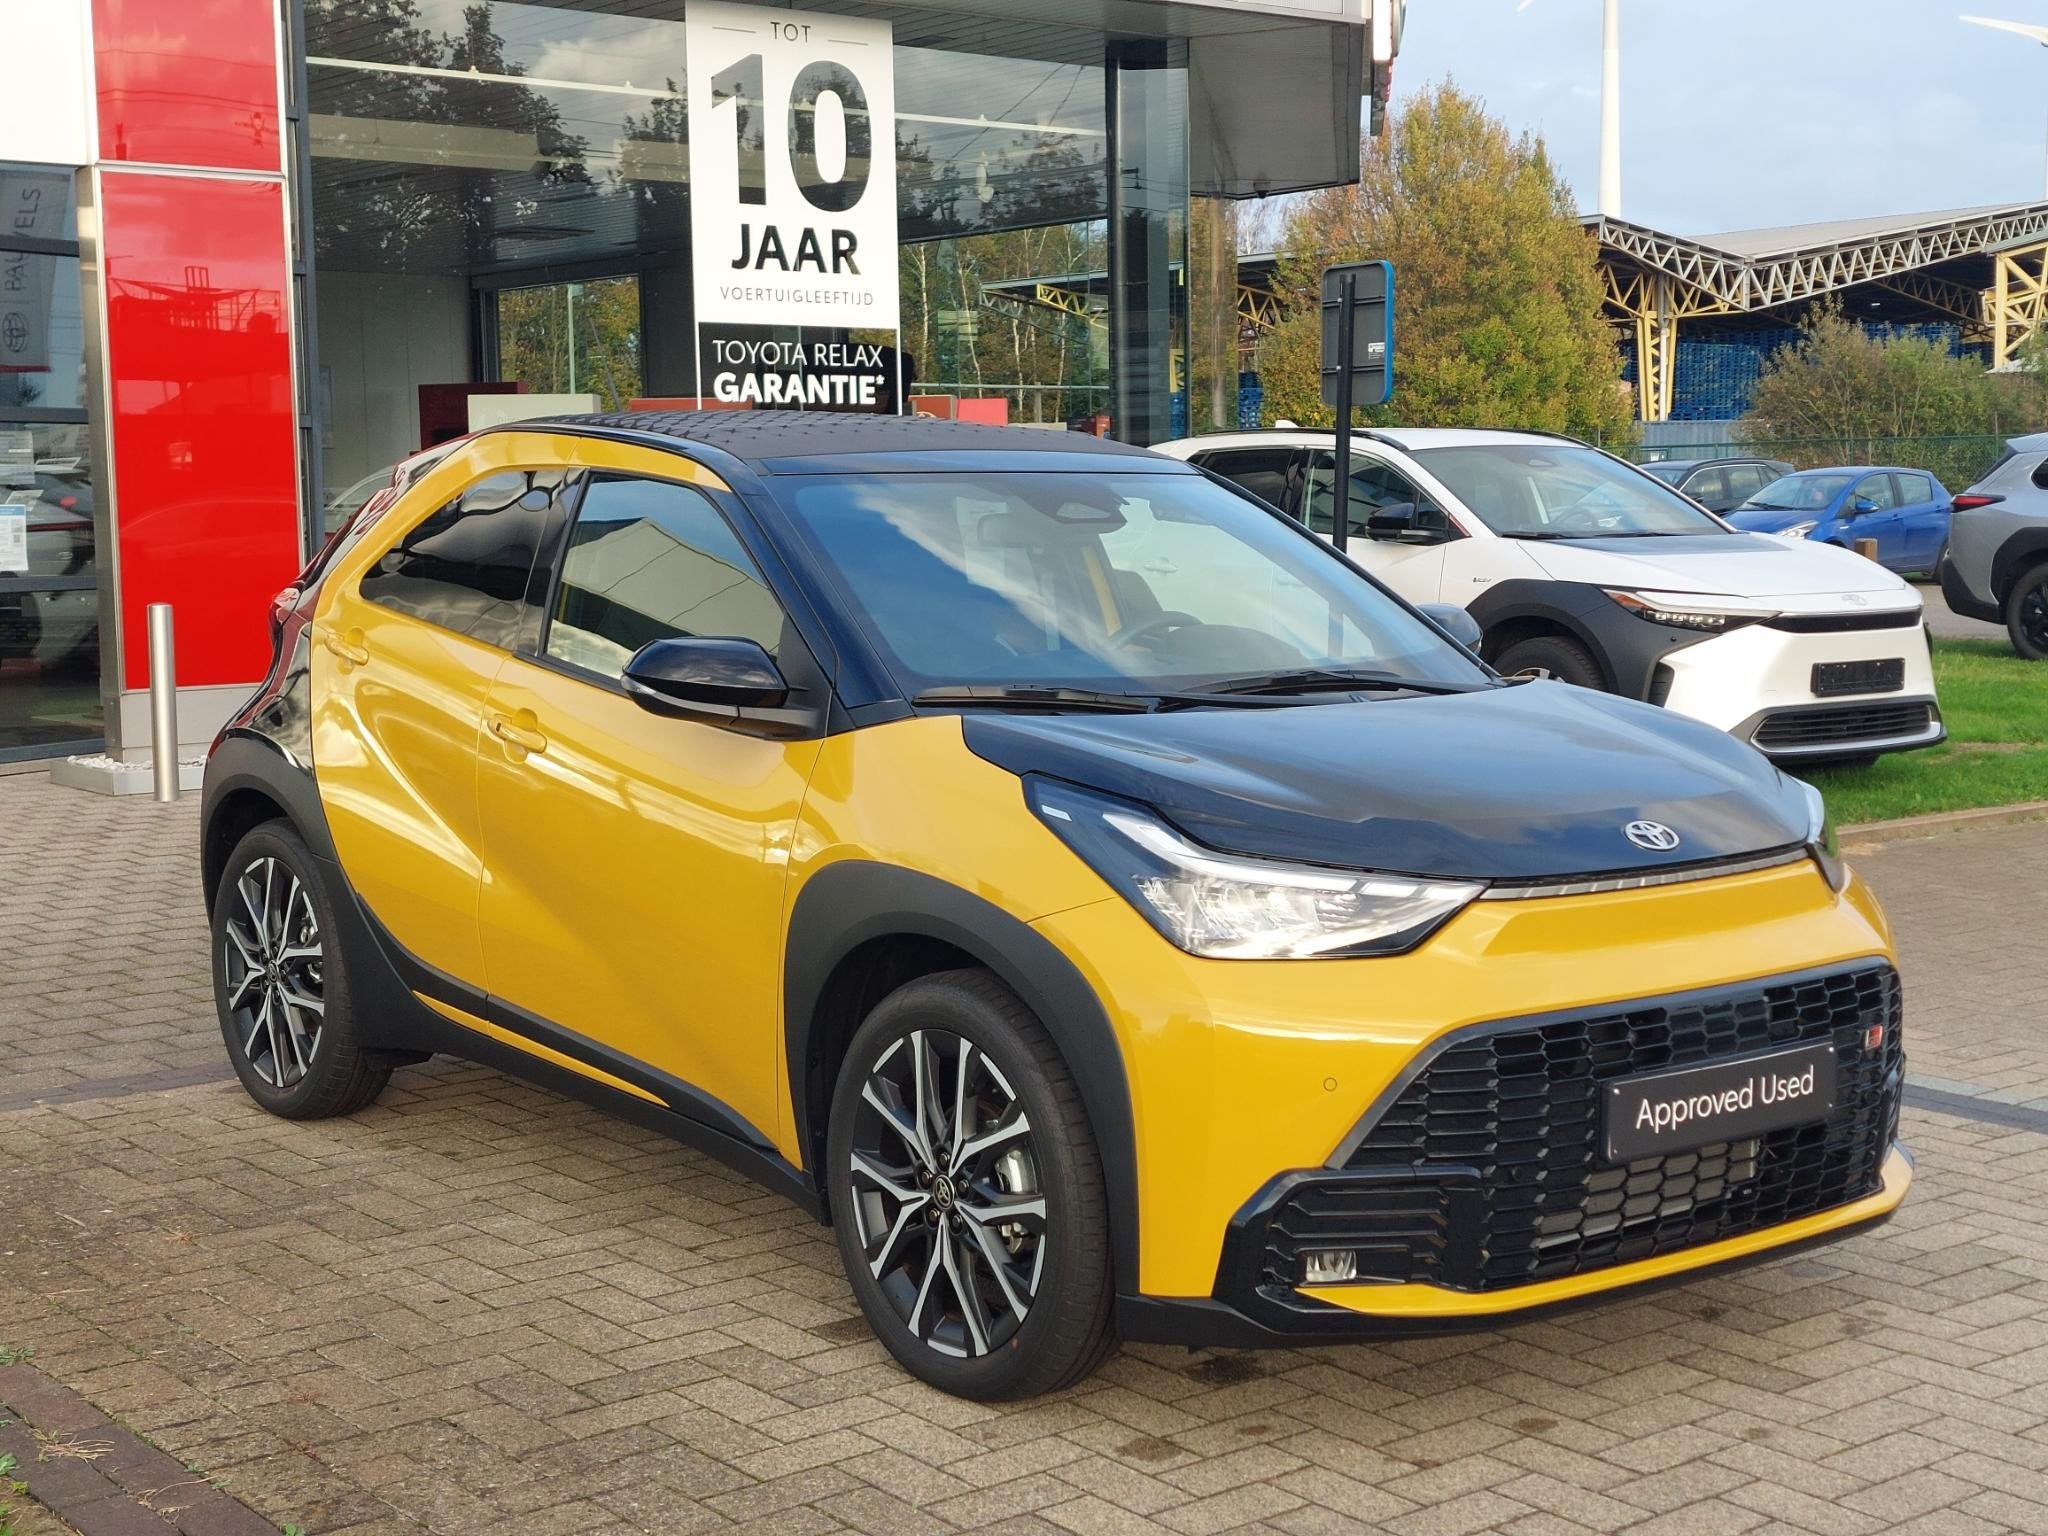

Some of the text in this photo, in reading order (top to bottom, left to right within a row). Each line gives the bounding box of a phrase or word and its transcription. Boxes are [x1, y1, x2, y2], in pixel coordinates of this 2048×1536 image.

[770, 21, 811, 43] TOT
[711, 53, 872, 213] 10
[731, 223, 861, 275] JAAR
[719, 286, 874, 306] VOERTUIGLEEFTIJD
[712, 339, 884, 368] TOYOTA RELAX
[1636, 1064, 1815, 1134] Approved Used
